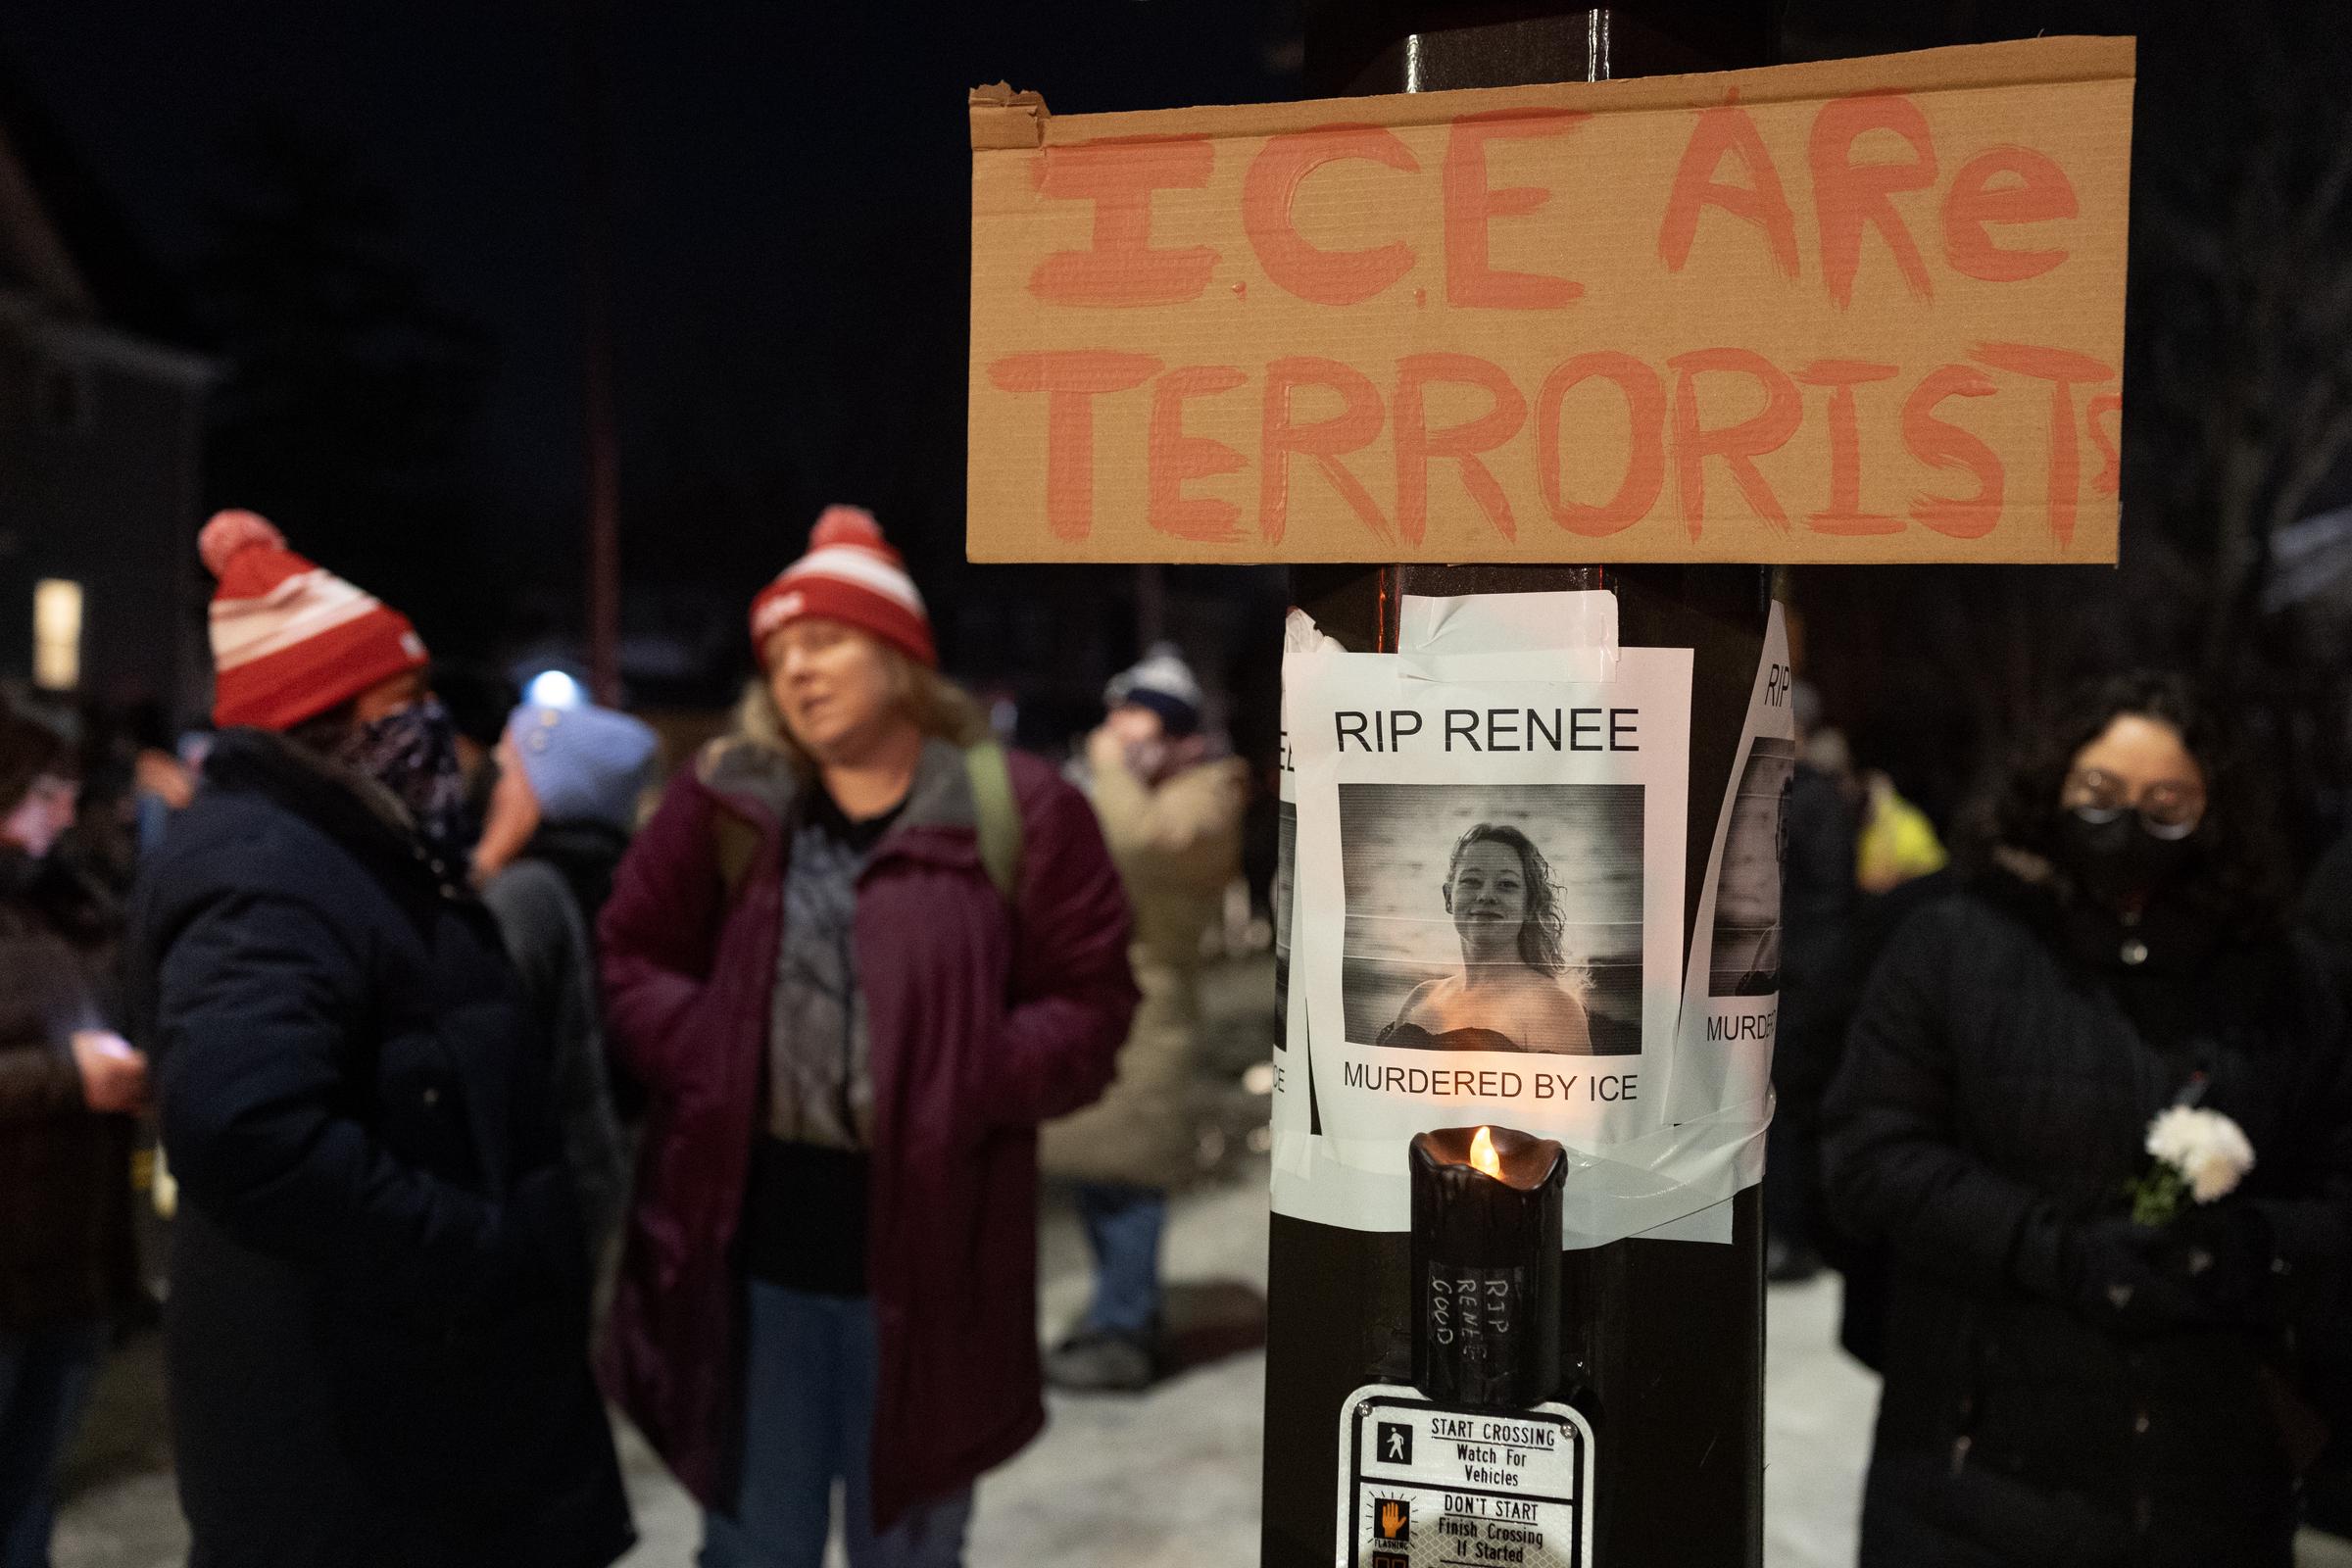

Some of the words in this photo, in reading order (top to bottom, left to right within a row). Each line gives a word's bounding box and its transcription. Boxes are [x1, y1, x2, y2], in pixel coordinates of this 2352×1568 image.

[1764, 663, 1790, 707] RIP
[1335, 711, 1422, 753] RIP
[1445, 709, 1640, 752] RENEE
[1344, 1061, 1523, 1099] MURDERED
[1535, 1073, 1578, 1100] BY
[1590, 1075, 1638, 1102] ICE
[1485, 1280, 1508, 1333] RIP
[1431, 1417, 1474, 1438] START
[1483, 1423, 1555, 1446] CROSSING
[1456, 1444, 1496, 1463] Watch
[1506, 1449, 1527, 1467] For
[1464, 1464, 1519, 1487] Vehicles
[1445, 1494, 1487, 1515] DON'T
[1495, 1501, 1539, 1521] START
[1374, 1538, 1409, 1550] FLASHING
[1439, 1517, 1478, 1539] Finish
[1488, 1523, 1544, 1549] Crossing
[1457, 1540, 1467, 1556] If
[1475, 1544, 1524, 1563] Started
